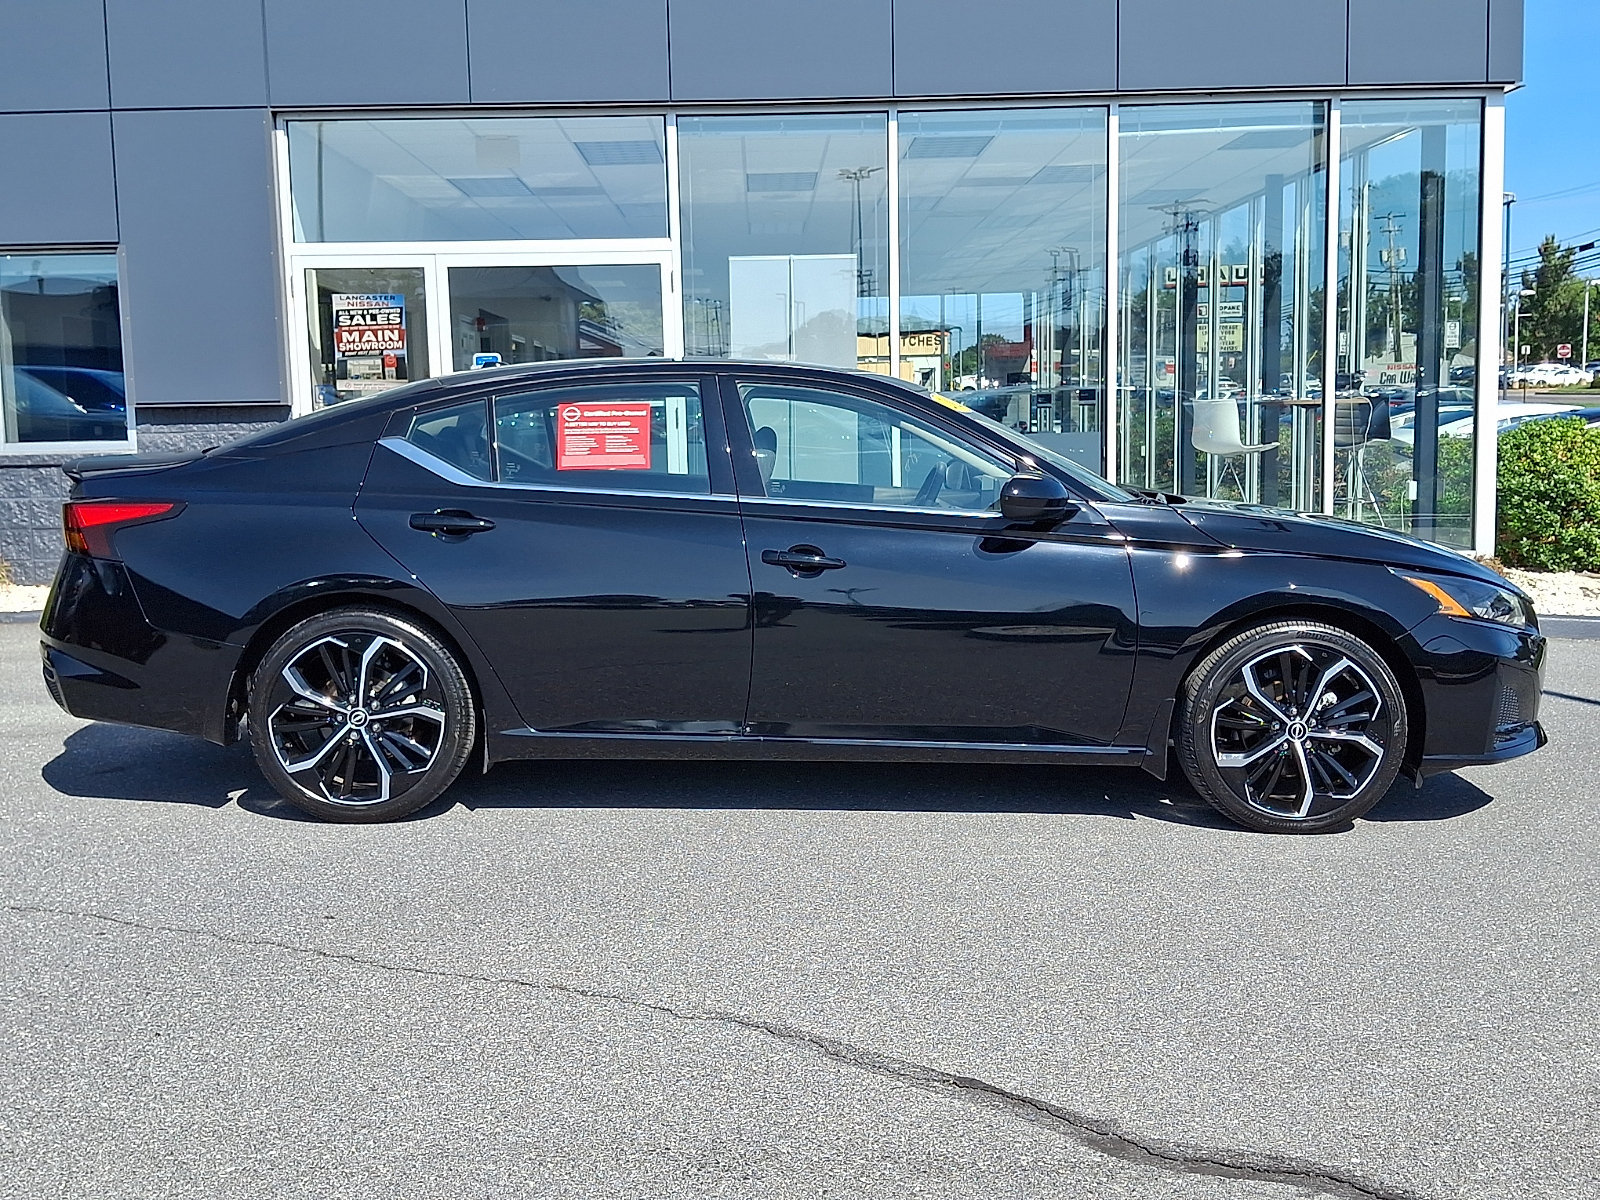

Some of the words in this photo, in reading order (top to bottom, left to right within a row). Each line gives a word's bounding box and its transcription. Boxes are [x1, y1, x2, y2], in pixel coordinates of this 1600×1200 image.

[338, 313, 401, 326] SALES
[341, 329, 399, 343] MAIN
[901, 336, 941, 346] TCHES
[339, 340, 403, 351] SHOWROOM
[1400, 371, 1416, 384] WA
